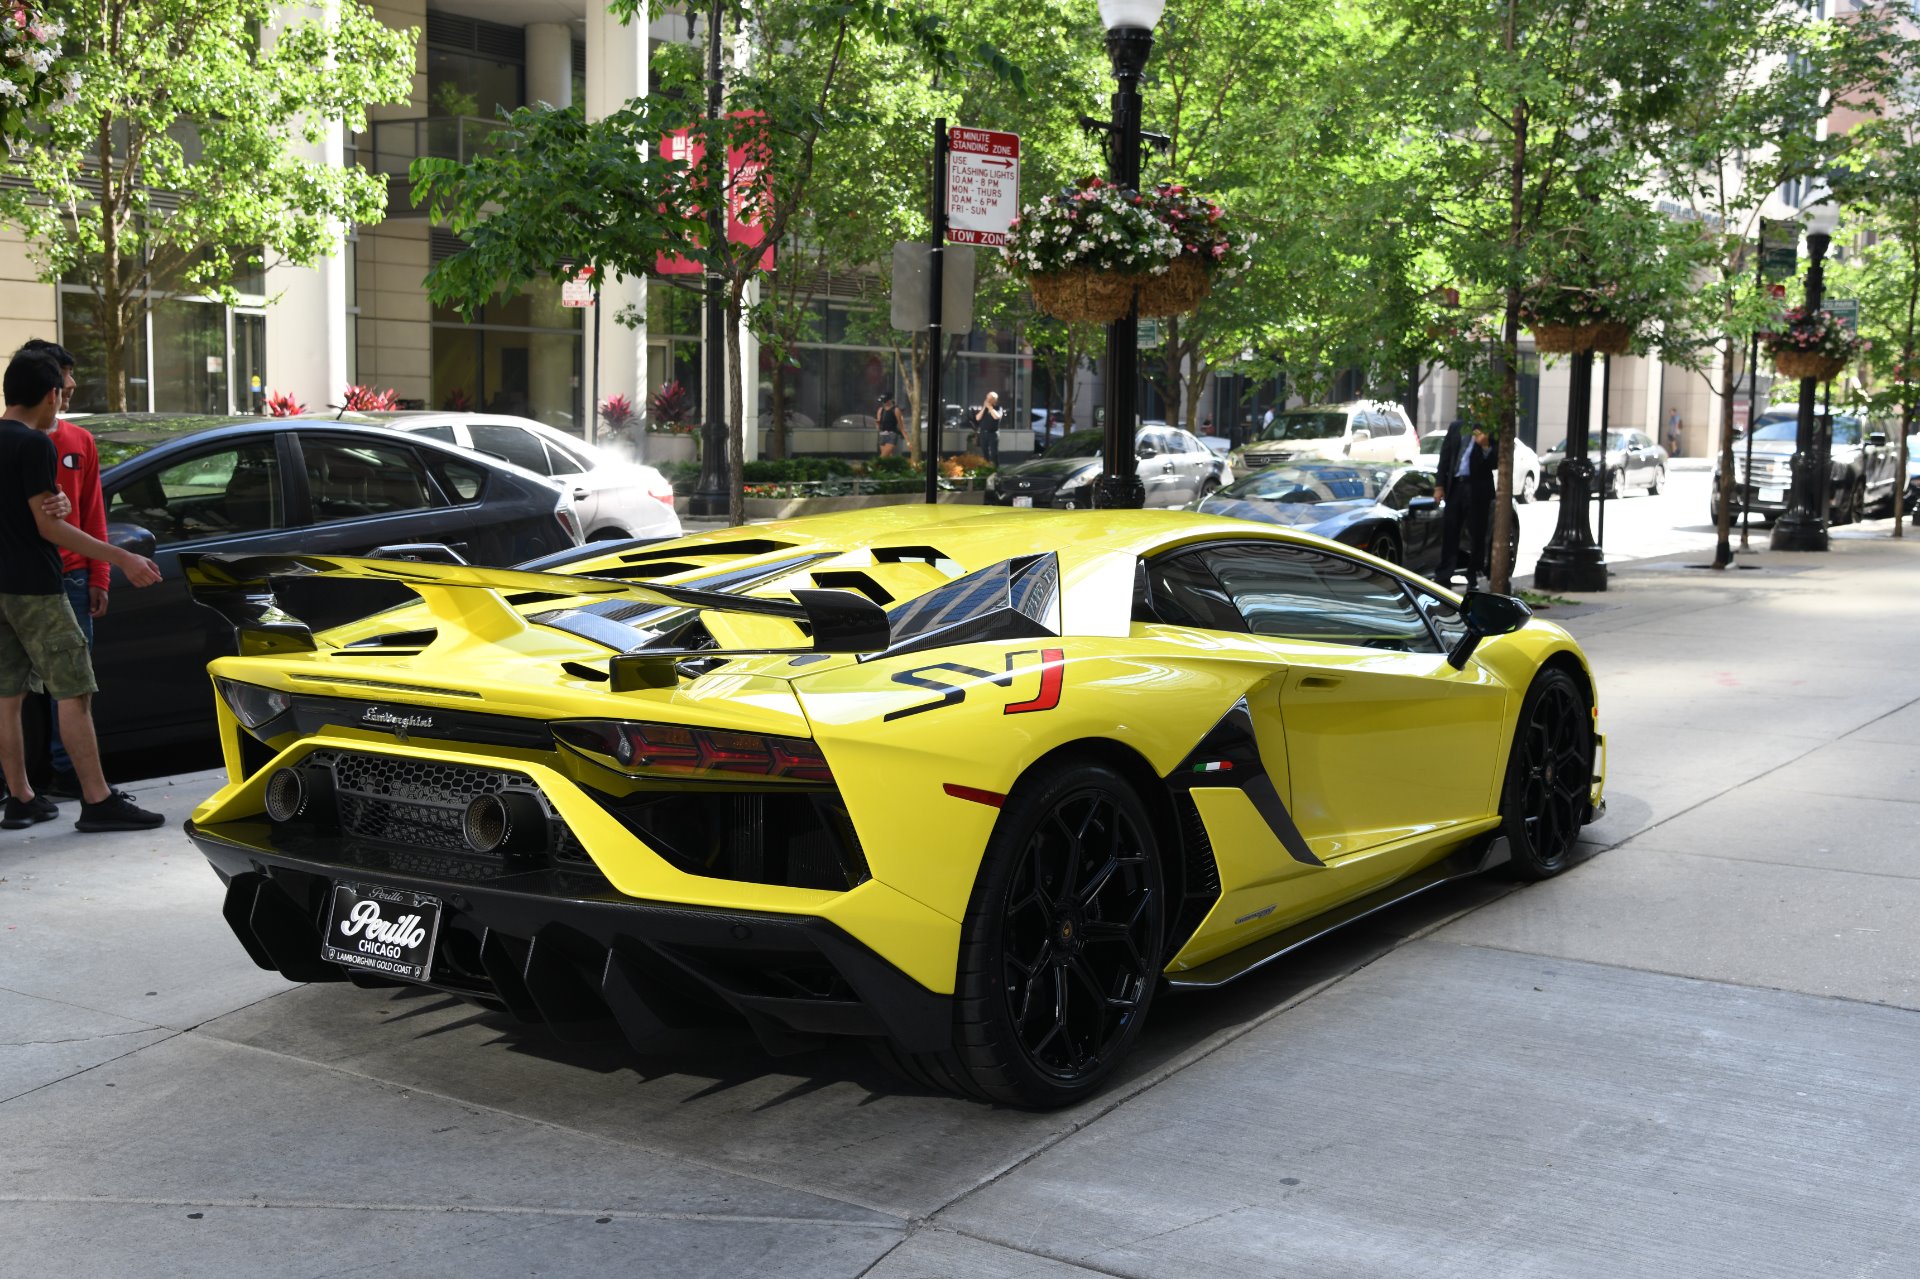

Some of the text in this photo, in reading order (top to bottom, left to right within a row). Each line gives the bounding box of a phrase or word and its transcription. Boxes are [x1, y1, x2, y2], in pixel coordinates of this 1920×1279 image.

[953, 131, 990, 142] 15 MINUTE
[953, 141, 1012, 155] STANDING ZONE
[952, 156, 967, 165] USE
[952, 166, 1014, 180] FLASHING LIGHTS
[952, 185, 968, 194] MON
[978, 187, 1002, 198] THURS
[951, 204, 964, 213] FRI
[971, 207, 987, 215] SUN
[952, 230, 975, 242] TOW
[363, 706, 433, 728] Lamborghini
[368, 887, 404, 902] Perillo
[340, 900, 426, 949] Perillo
[358, 940, 400, 959] CHICAGO
[337, 952, 412, 975] LAMBORGHINI GOLD COAST
